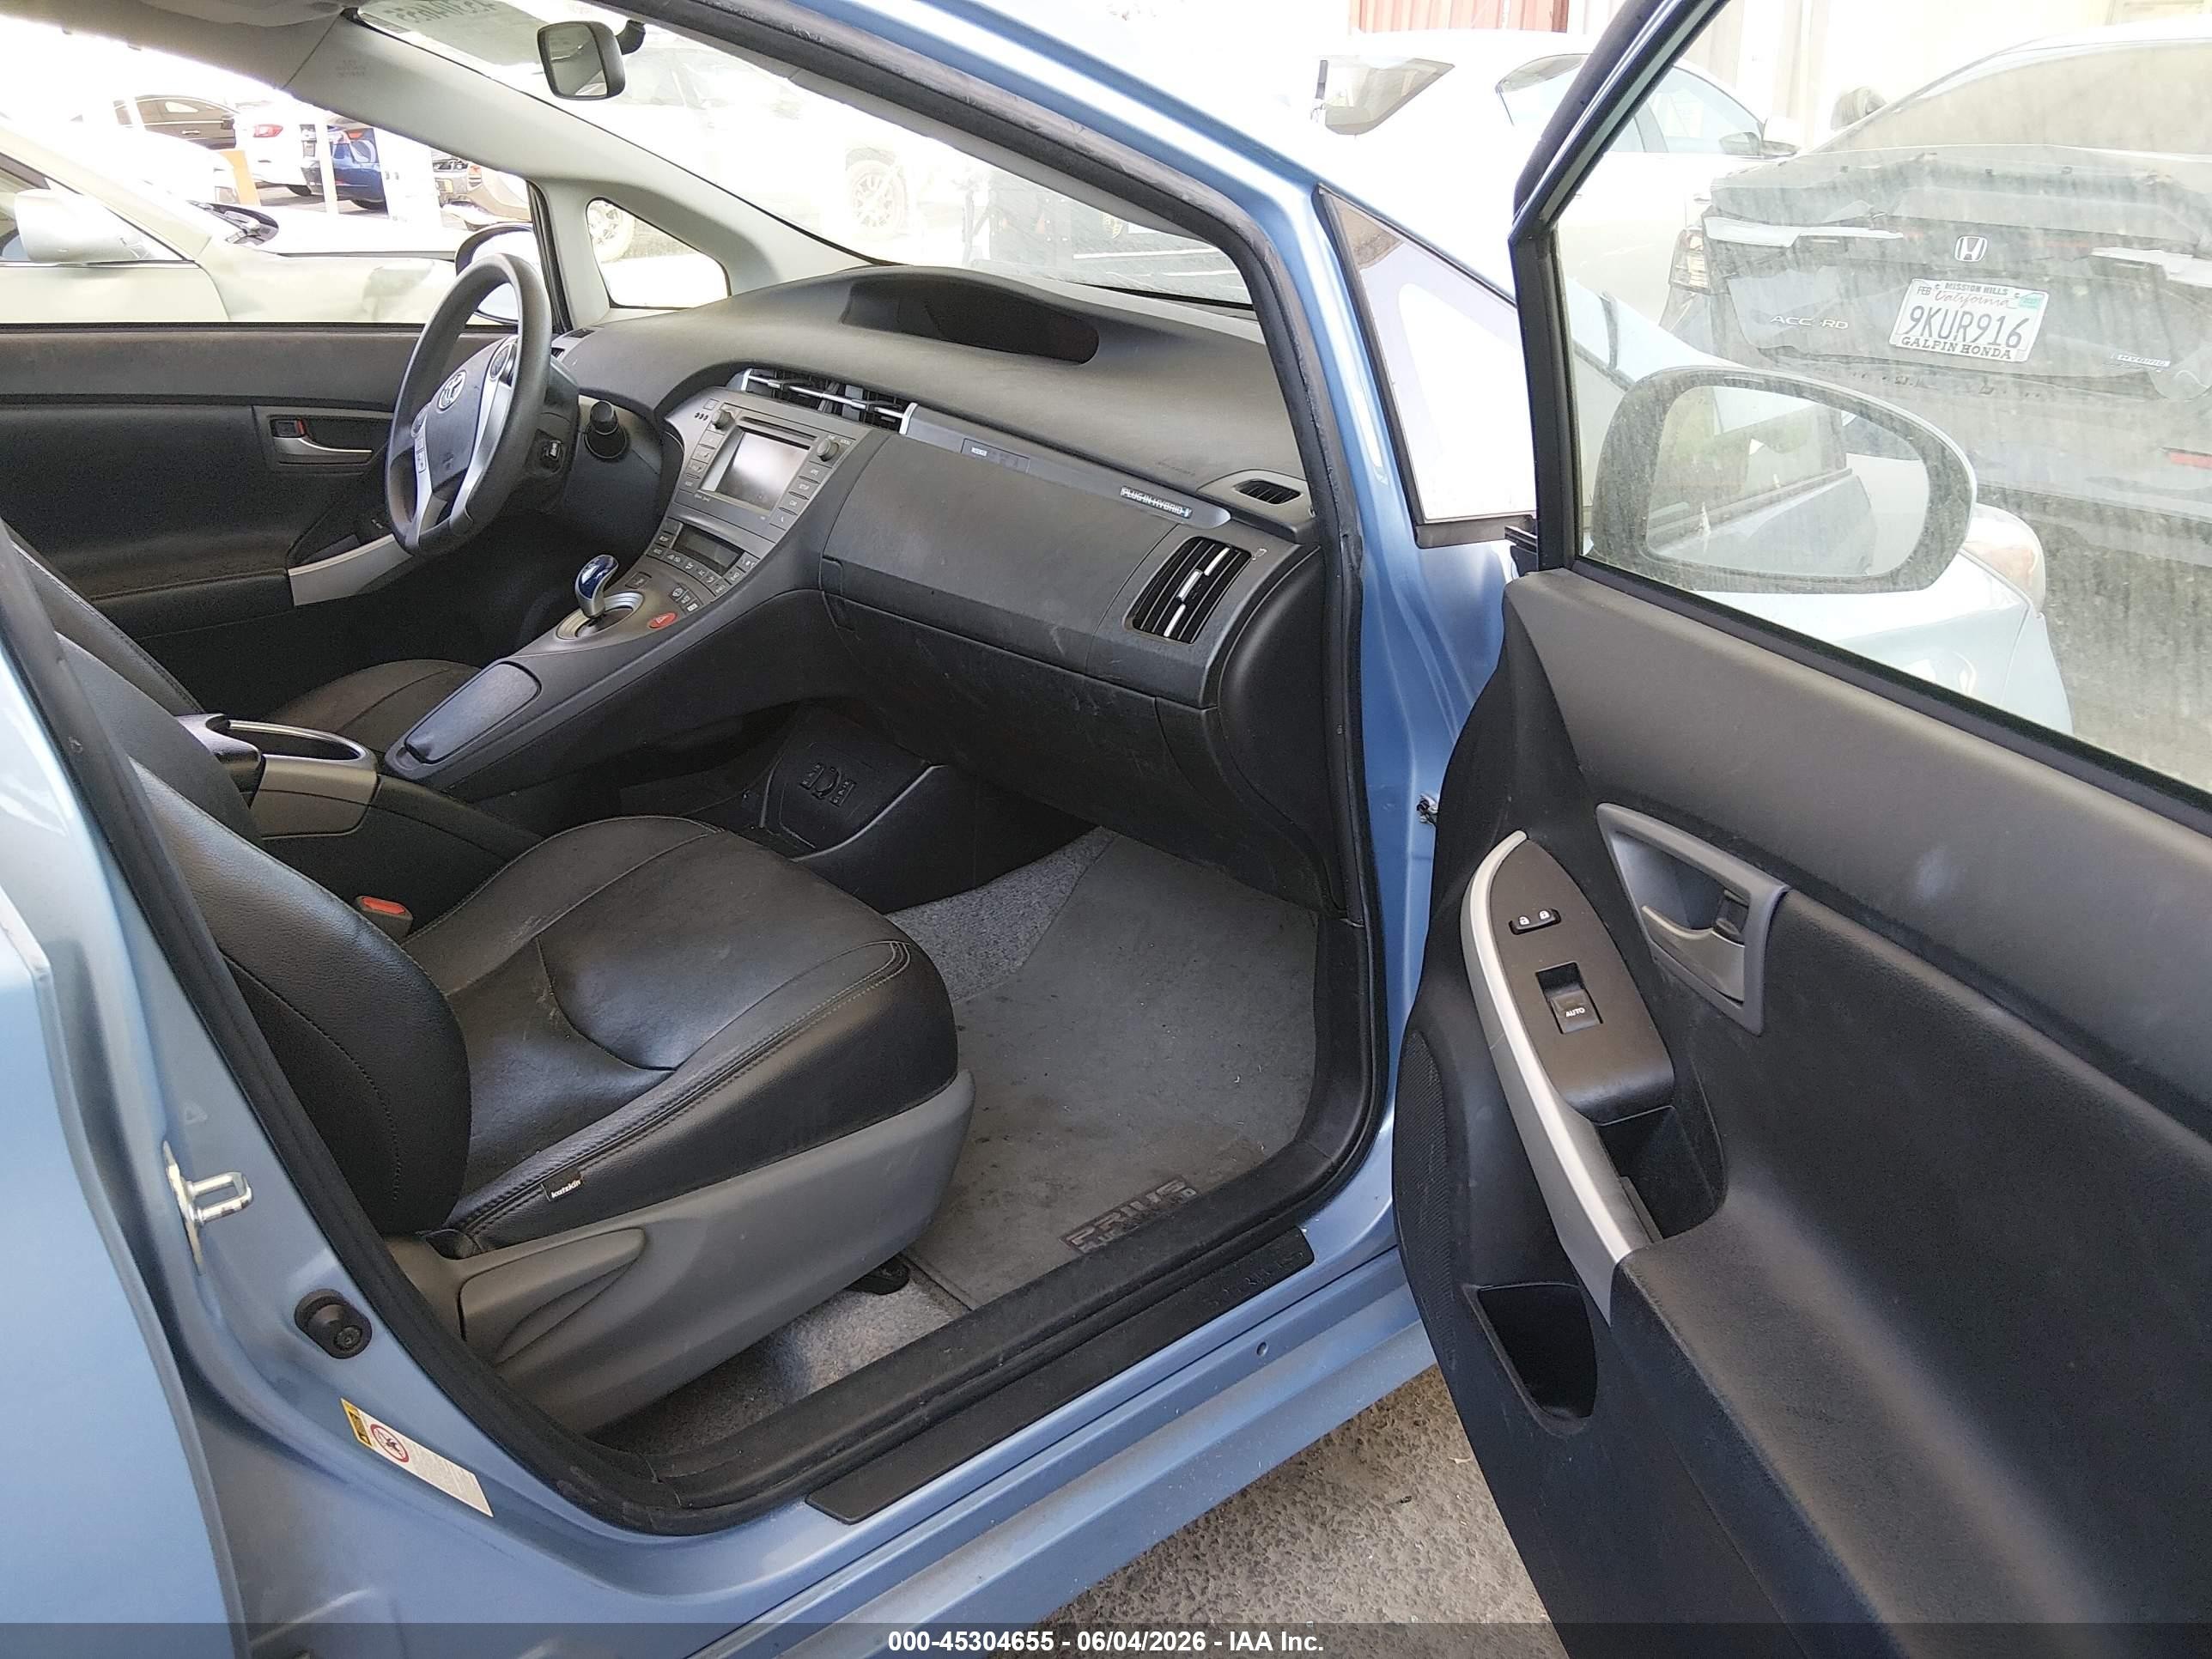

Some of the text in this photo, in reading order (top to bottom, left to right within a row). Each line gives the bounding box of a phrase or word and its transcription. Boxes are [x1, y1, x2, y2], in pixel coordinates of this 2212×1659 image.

[1917, 286, 1932, 295] FEB
[1944, 283, 2009, 296] MISSION HILLS
[1935, 290, 2017, 309] California
[1770, 315, 1849, 330] ACCRD
[1904, 305, 2030, 349] 9KUR916
[1901, 336, 2012, 360] GALPIN HONDA
[1565, 1006, 1586, 1018] AUTO
